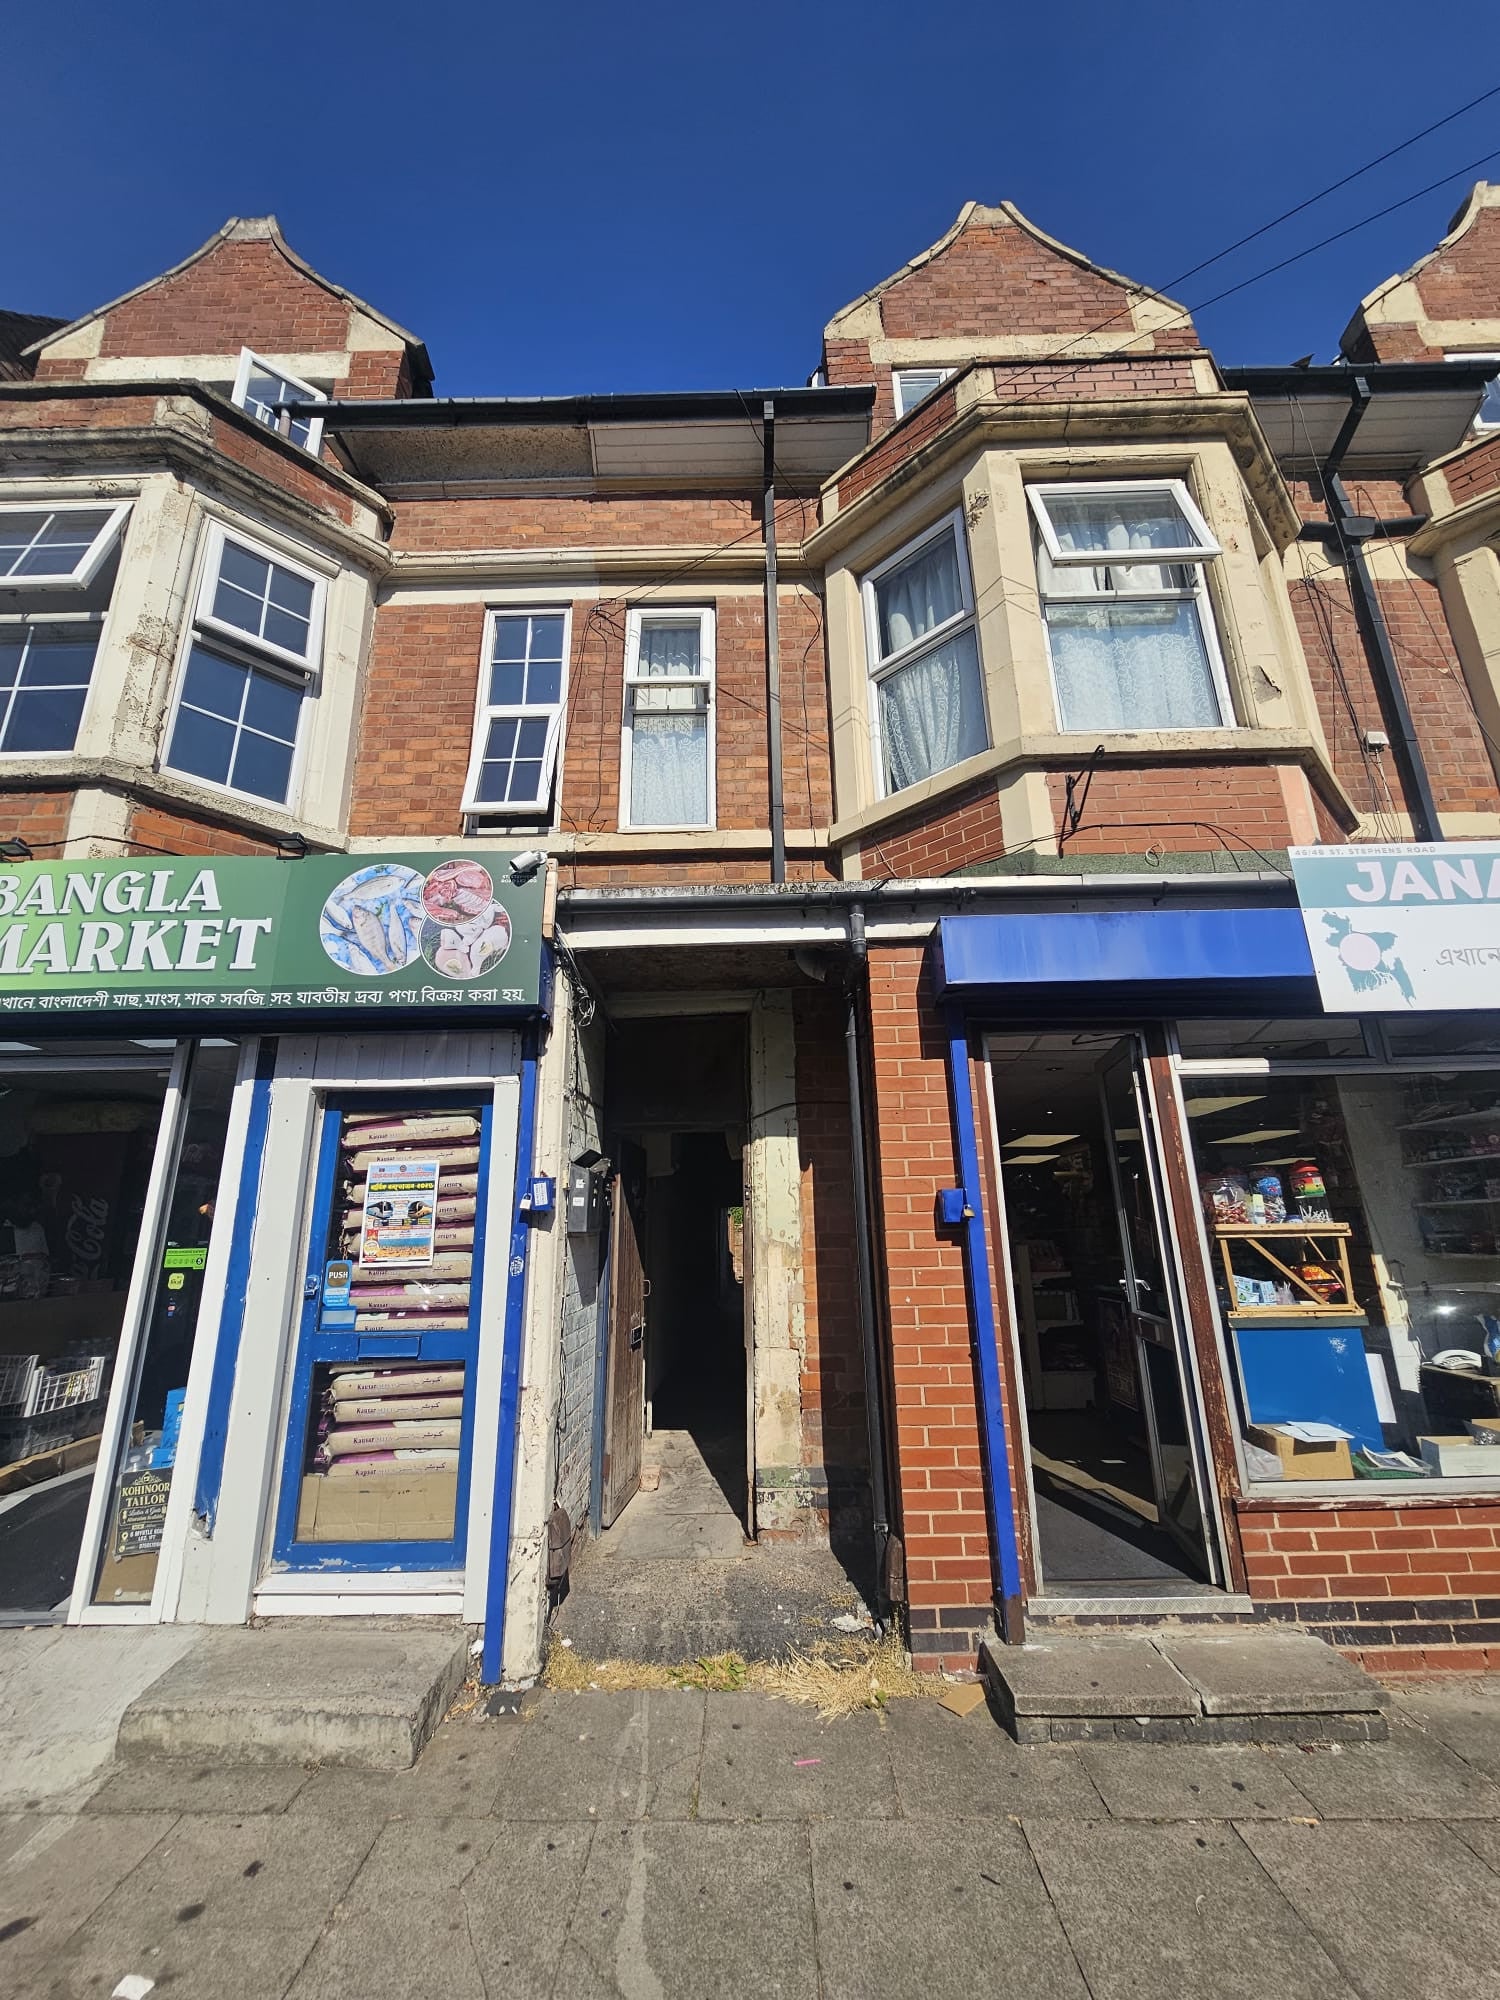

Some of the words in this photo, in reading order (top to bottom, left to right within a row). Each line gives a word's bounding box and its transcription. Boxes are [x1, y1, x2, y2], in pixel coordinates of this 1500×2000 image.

[1348, 847, 1402, 855] STEPHENS
[1406, 846, 1436, 854] ROAD
[0, 870, 222, 916] BANGLA
[0, 996, 36, 1009] খানে
[38, 990, 110, 1009] বাংলাদেশী
[184, 992, 216, 1006] শাক
[297, 986, 350, 1005] যাবতীয়
[421, 985, 464, 1003] বিক্রয়
[468, 988, 498, 1001] করা
[328, 1271, 348, 1279] PUSH
[122, 1482, 170, 1497] KOHINOOR
[126, 1494, 165, 1507] TAILOR
